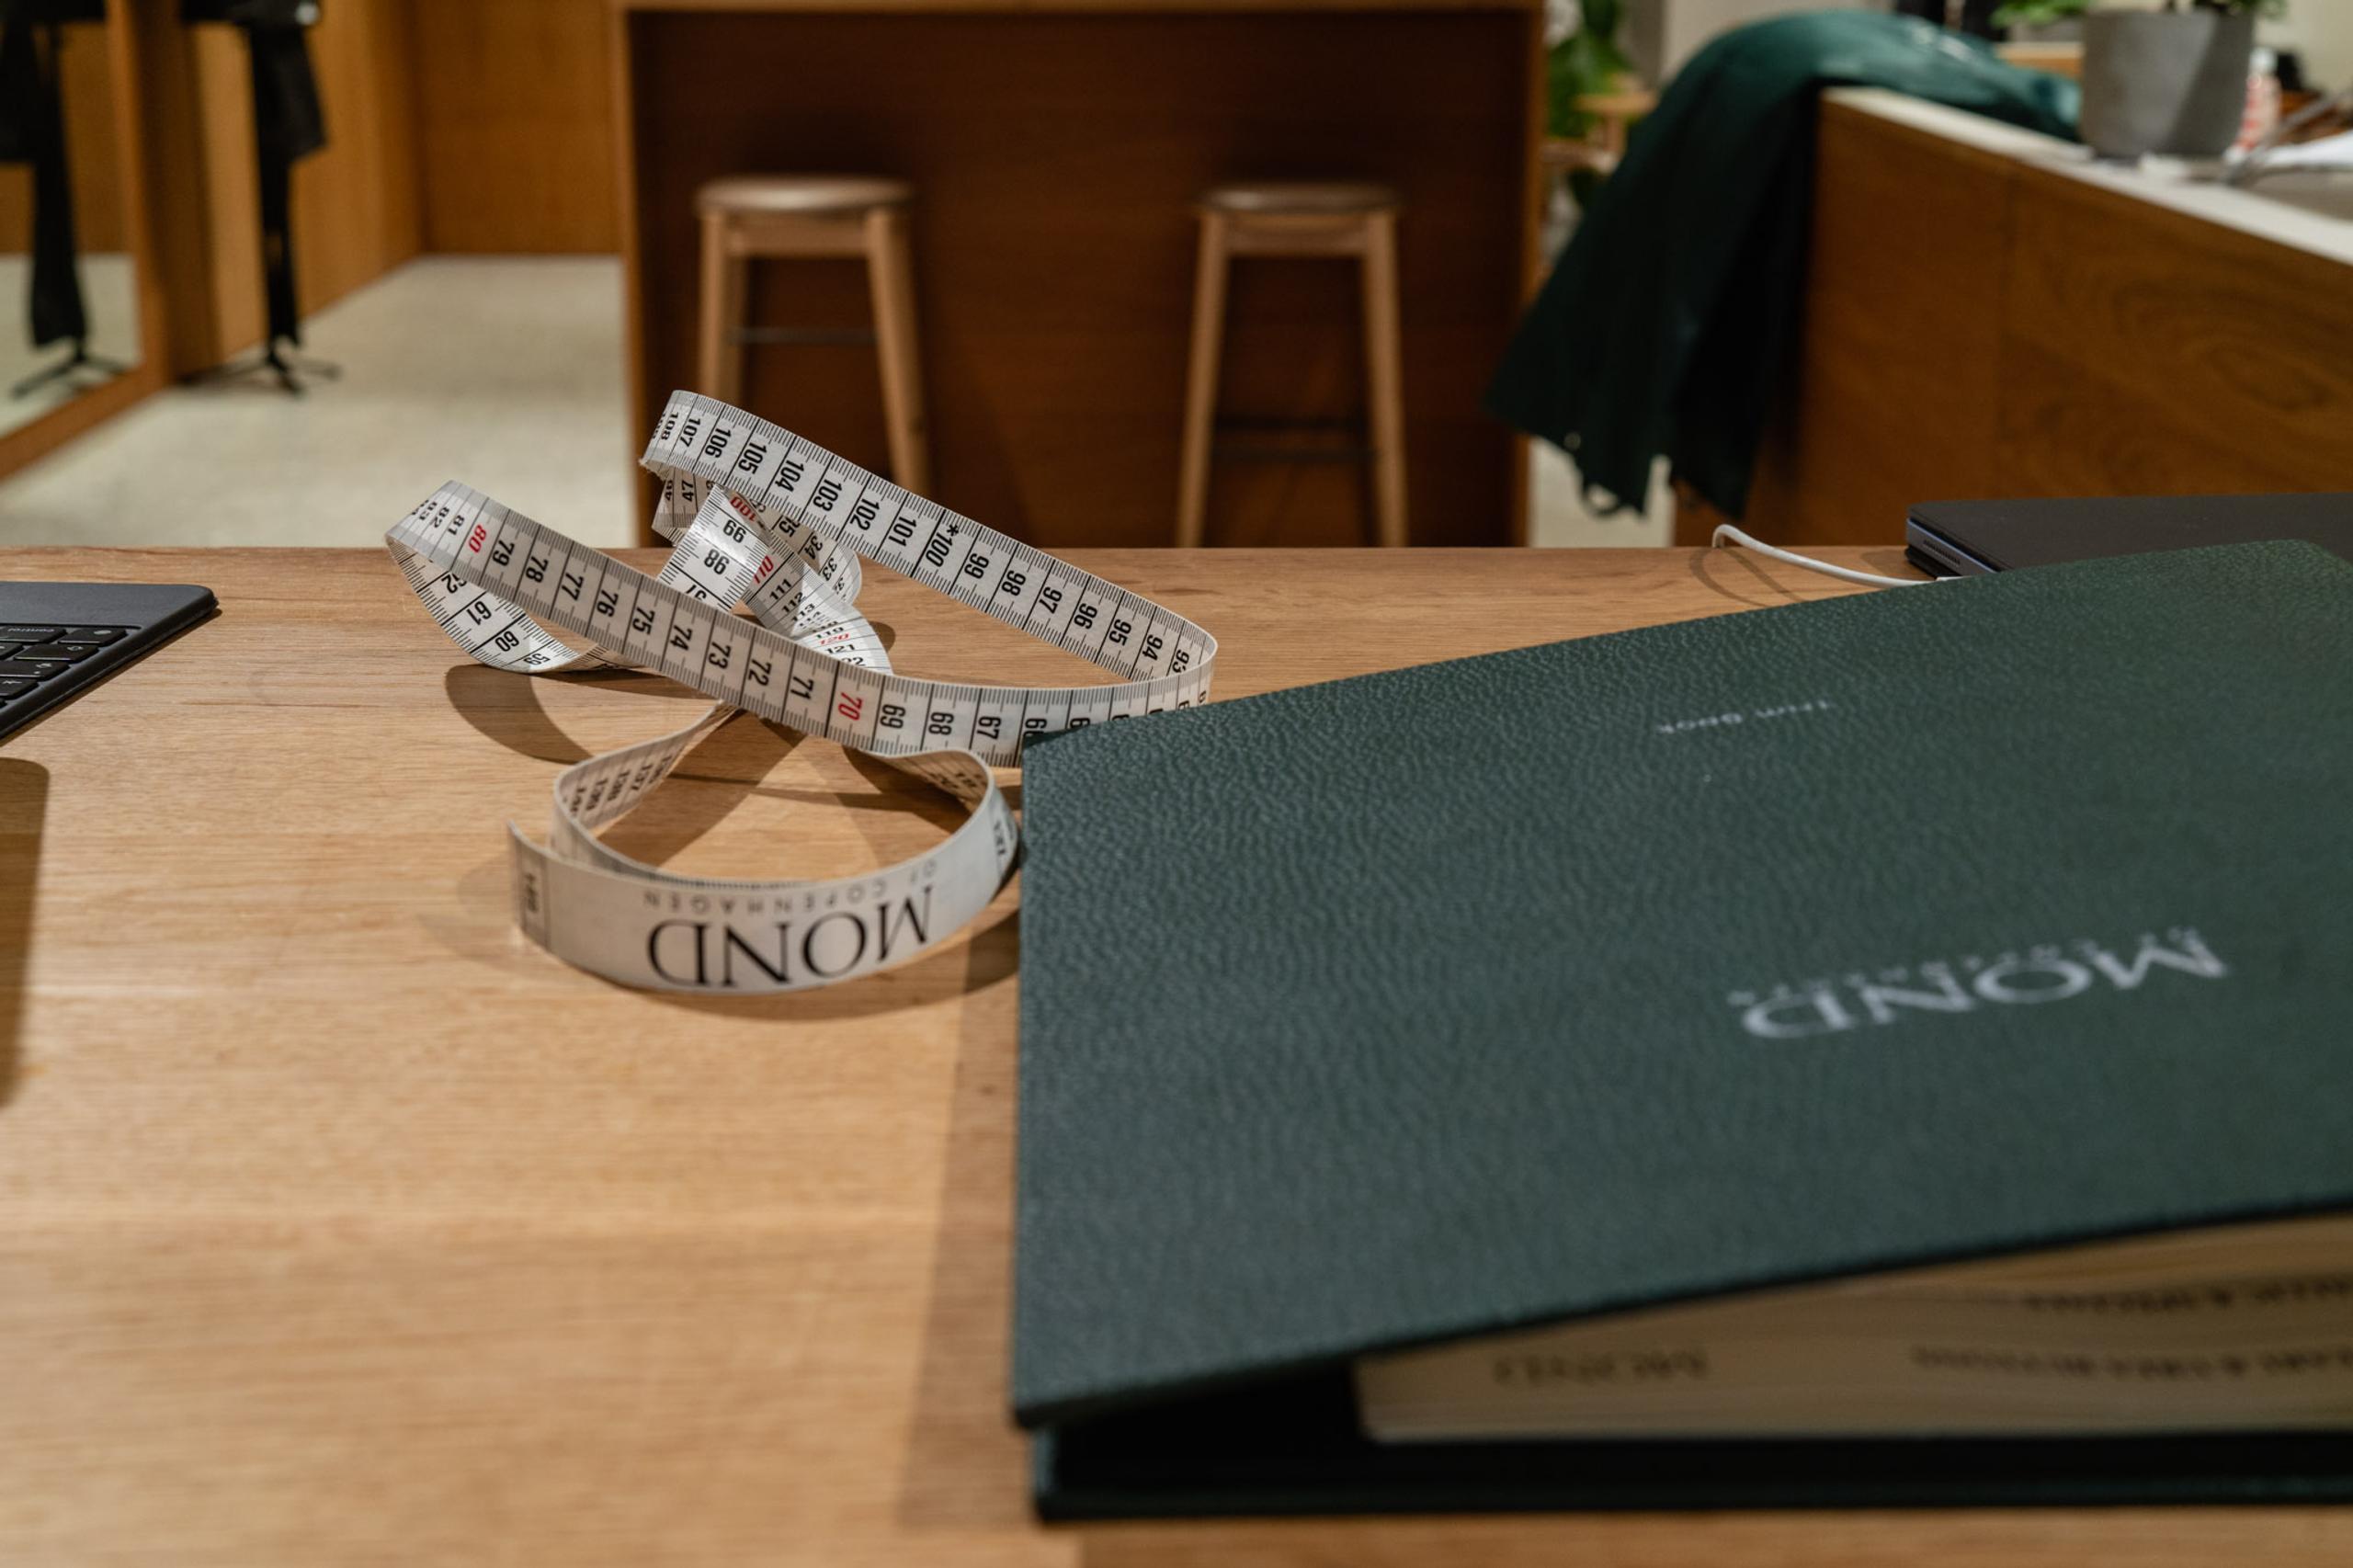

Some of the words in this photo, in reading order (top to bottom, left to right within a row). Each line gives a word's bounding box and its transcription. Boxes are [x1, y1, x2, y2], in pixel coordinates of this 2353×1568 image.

[661, 412, 679, 440] 108
[680, 418, 701, 448] 107
[705, 427, 732, 459] 106
[738, 441, 767, 475] 105
[774, 459, 805, 494] 104
[681, 480, 695, 502] 47
[813, 478, 843, 512] 103
[430, 506, 450, 528] 82
[448, 515, 465, 536] 81
[849, 497, 881, 532] 102
[467, 524, 487, 553] 80
[722, 519, 747, 543] 99
[888, 515, 917, 548] 101
[492, 539, 515, 566] 79
[803, 535, 824, 560] 34
[525, 555, 549, 584] 78
[704, 549, 731, 575] 98
[822, 558, 837, 582] 33
[964, 552, 990, 579] 99
[561, 572, 584, 601] 77
[769, 578, 791, 600] 111
[1001, 569, 1027, 597] 98
[465, 600, 493, 626] 61
[597, 589, 620, 618] 76
[782, 591, 805, 613] 112
[791, 603, 815, 622] 113
[1039, 585, 1063, 614] 97
[632, 607, 655, 635] 75
[1074, 602, 1098, 630] 96
[494, 631, 520, 653] 60
[670, 624, 693, 652] 74
[1108, 619, 1131, 646] 95
[709, 641, 732, 670] 73
[825, 643, 856, 654] 121
[1142, 633, 1164, 662] 94
[1172, 649, 1190, 674] 93
[747, 657, 772, 687] 72
[790, 675, 814, 701] 71
[838, 691, 863, 722] 70
[880, 703, 906, 731] 69
[928, 711, 954, 737] 68
[976, 716, 1002, 741] 67
[642, 878, 887, 917] COPENHAGEN
[647, 884, 933, 988] MOND
[1743, 937, 2228, 1039] MOND
